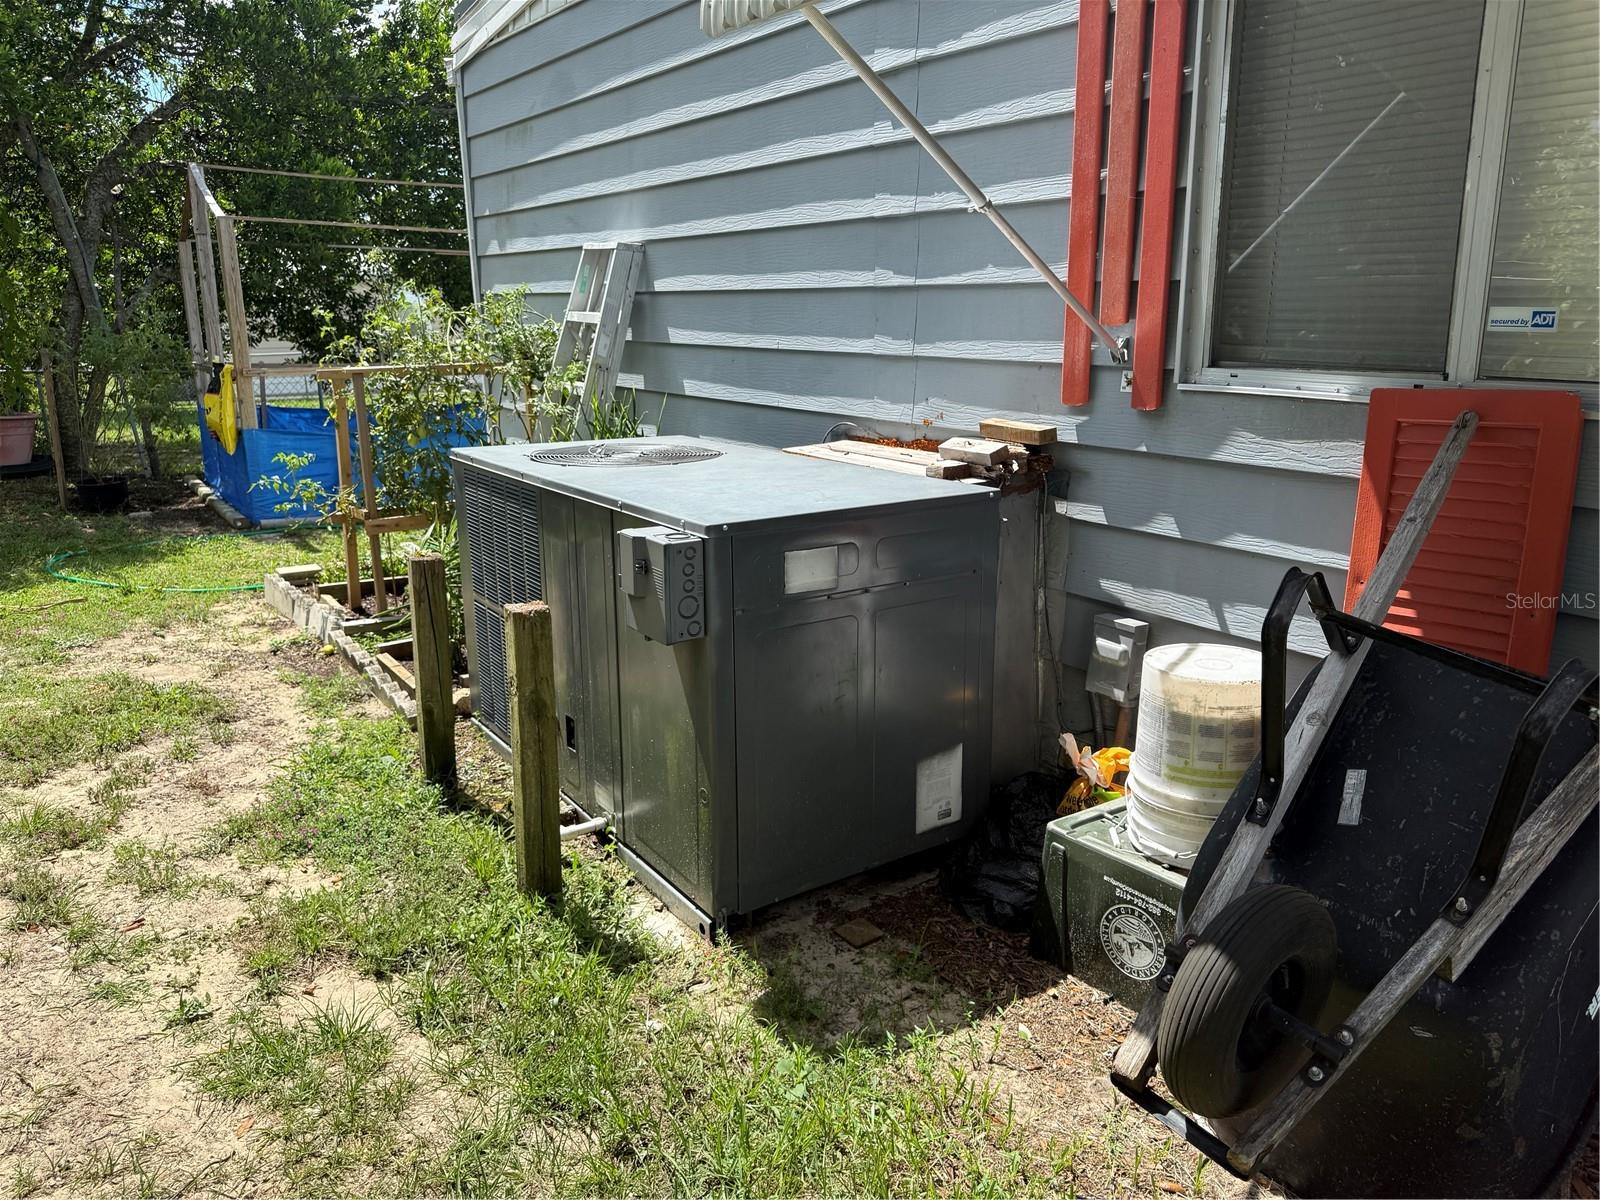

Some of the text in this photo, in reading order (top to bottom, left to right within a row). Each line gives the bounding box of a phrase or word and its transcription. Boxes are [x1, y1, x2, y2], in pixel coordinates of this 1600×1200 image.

[1531, 313, 1556, 326] ADT
[1112, 907, 1159, 935] FLORIDA
[1102, 919, 1165, 978] HERNANDO COUNTY
